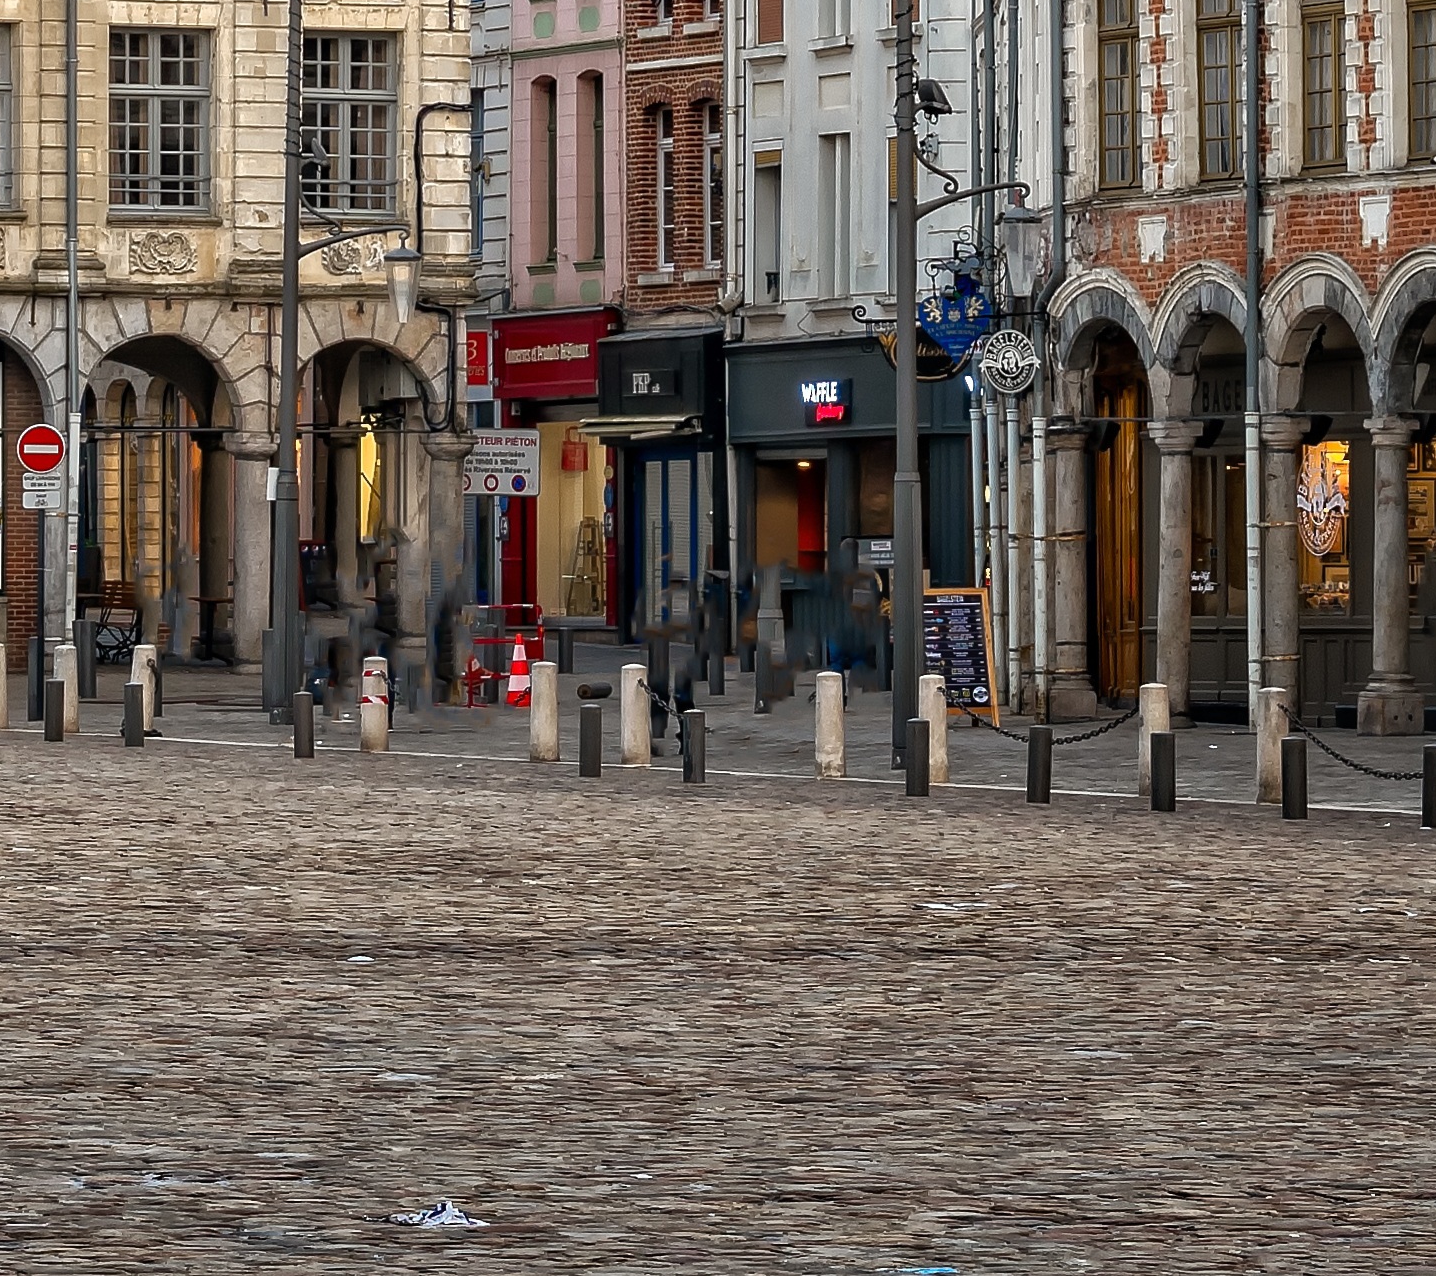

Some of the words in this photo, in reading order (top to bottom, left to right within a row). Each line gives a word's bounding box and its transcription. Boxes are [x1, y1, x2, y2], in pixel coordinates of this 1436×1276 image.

[986, 332, 1033, 360] BAGELSTEIN
[801, 381, 838, 403] WAFFLE
[478, 436, 503, 446] TEUR
[504, 435, 537, 447] PIÉTON
[504, 466, 532, 474] Réservé
